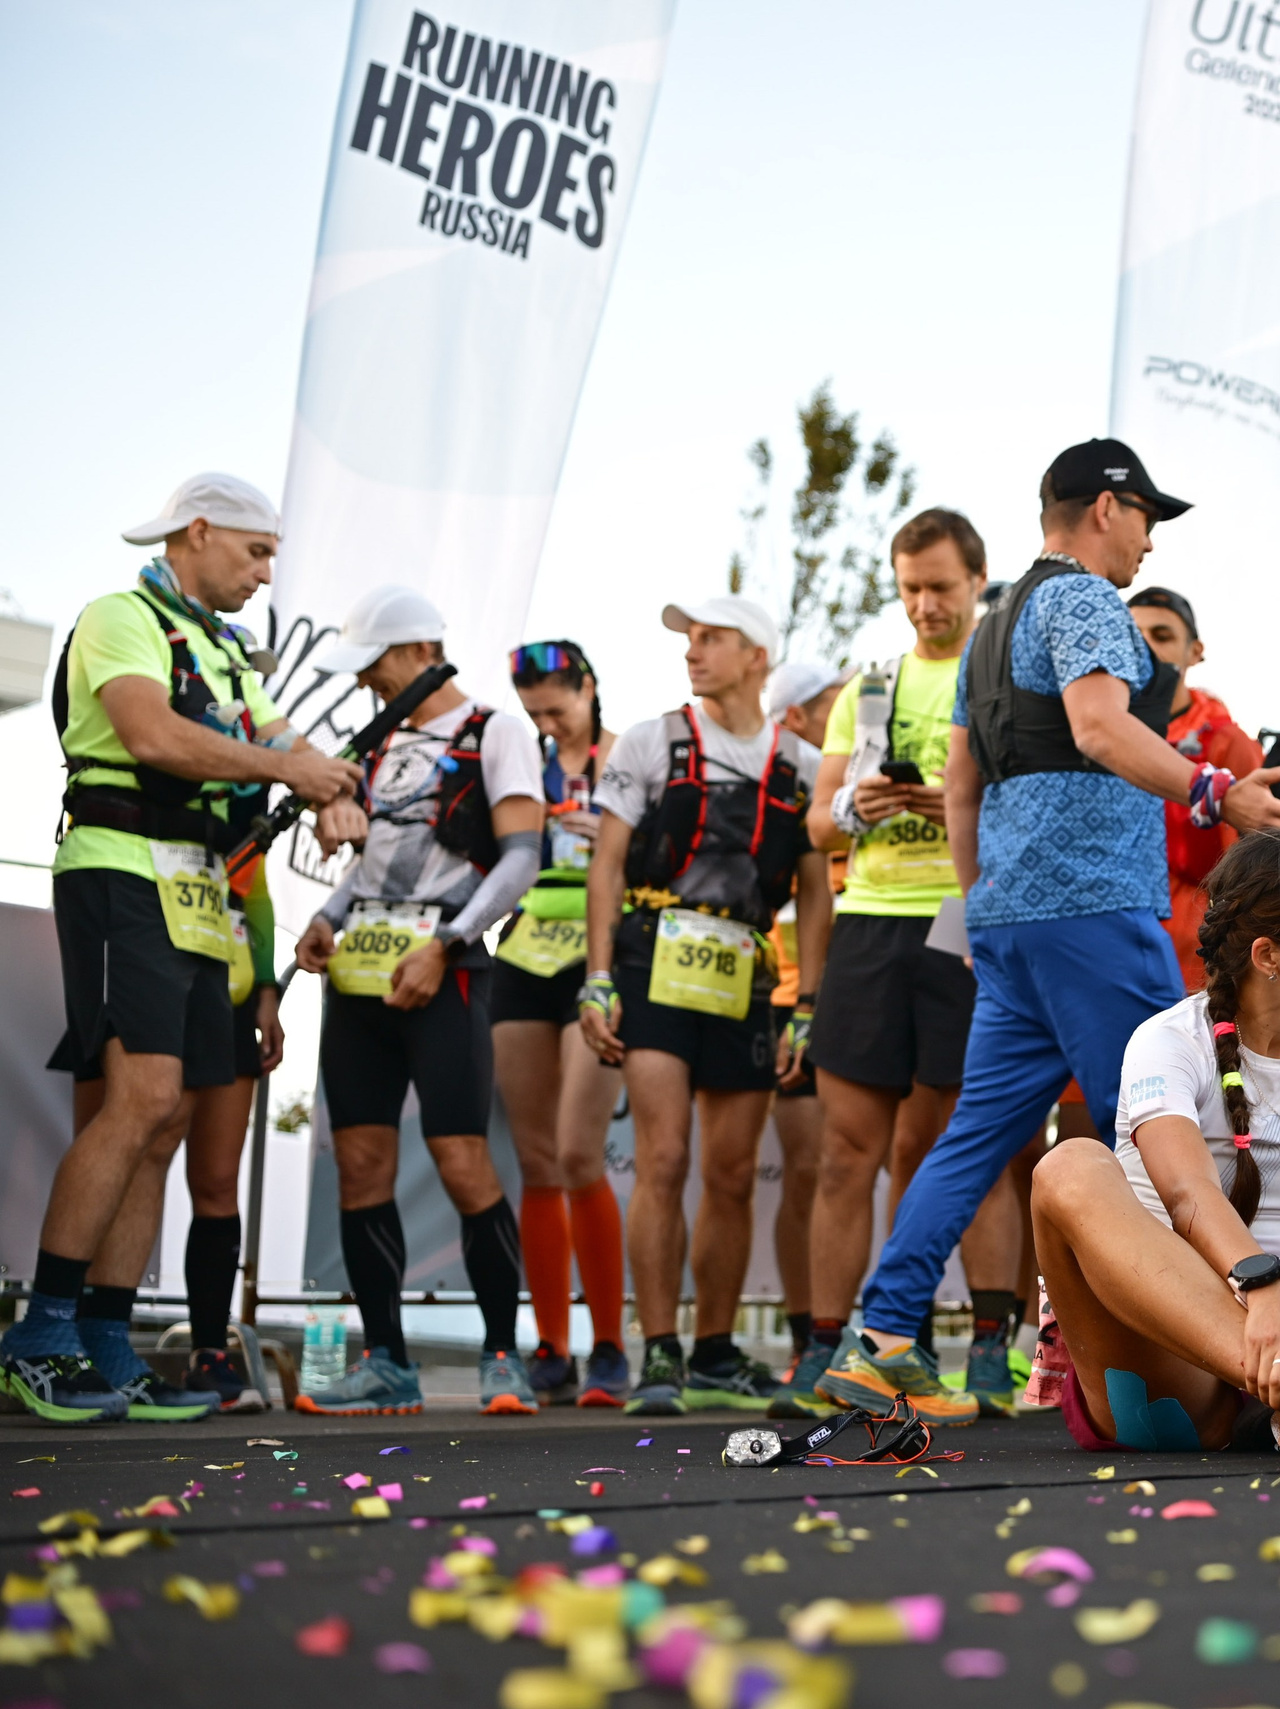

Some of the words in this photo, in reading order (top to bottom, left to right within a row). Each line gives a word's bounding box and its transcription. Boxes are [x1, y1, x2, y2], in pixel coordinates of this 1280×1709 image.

[402, 8, 617, 144] RUNNING
[350, 59, 616, 250] HEROES
[418, 188, 533, 260] RUSSIA
[888, 819, 948, 846] 386
[345, 929, 413, 957] 3089
[677, 942, 737, 977] 3918
[808, 1427, 832, 1448] PETZL
